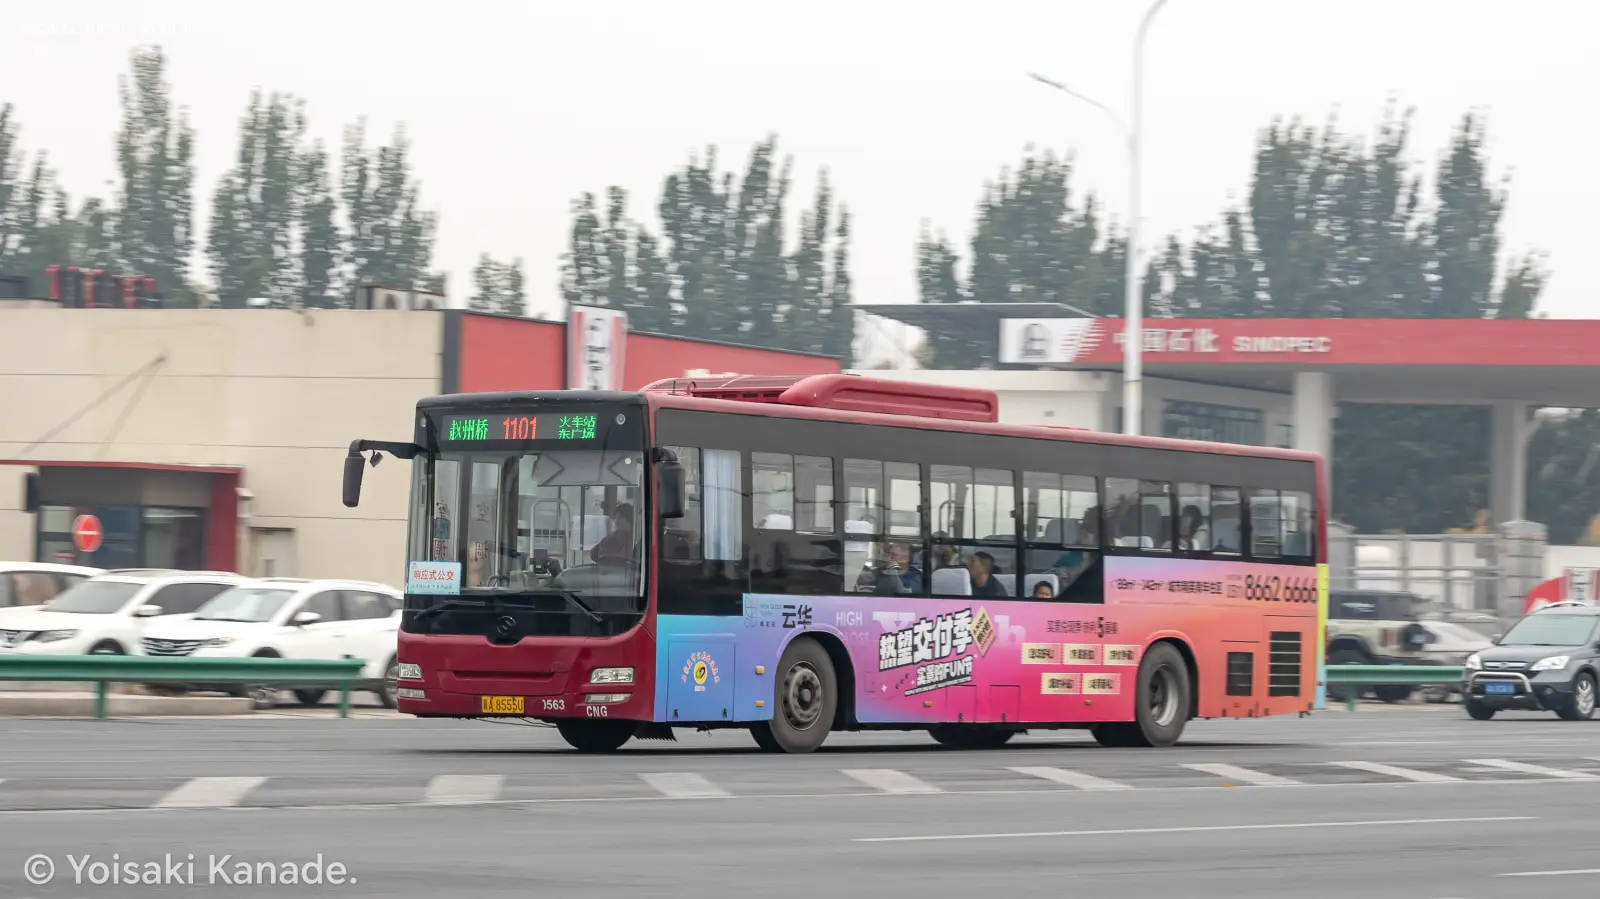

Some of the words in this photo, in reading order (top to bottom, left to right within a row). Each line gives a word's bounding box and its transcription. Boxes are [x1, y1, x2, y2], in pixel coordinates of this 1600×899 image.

[1232, 336, 1332, 352] SINOPEC
[449, 418, 488, 440] 赵州桥
[503, 416, 537, 440] 1101
[559, 415, 596, 428] 火车站
[558, 427, 595, 439] 东广场
[413, 570, 455, 581] 响应式公交
[1244, 574, 1281, 602] 8662
[1283, 576, 1317, 604] 6666
[782, 604, 813, 629] 云华
[836, 610, 863, 626] HIGH
[879, 608, 973, 672] 热望交付季
[586, 706, 608, 717] CNG
